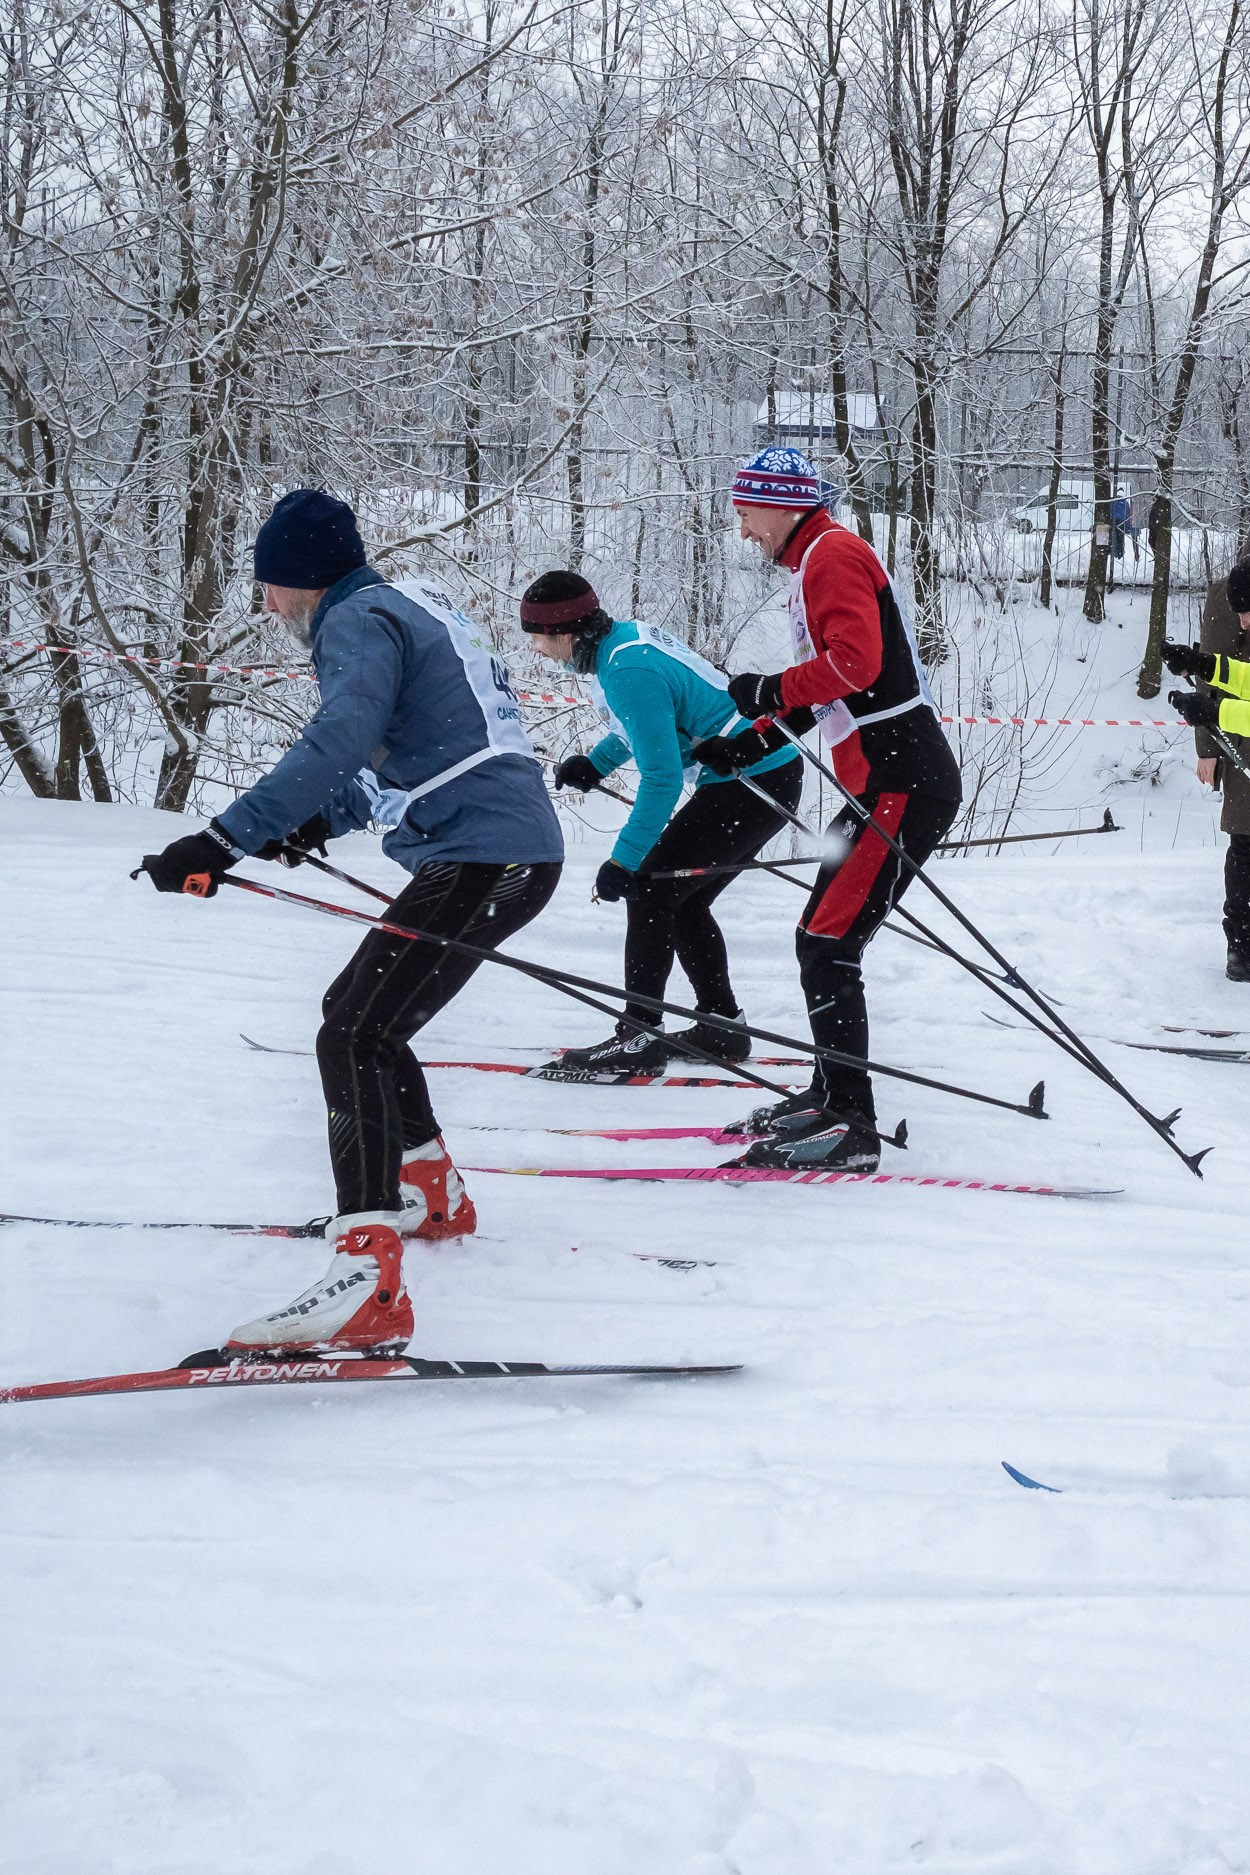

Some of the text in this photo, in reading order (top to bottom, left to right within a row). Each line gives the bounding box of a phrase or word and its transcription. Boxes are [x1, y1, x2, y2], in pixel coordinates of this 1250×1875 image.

[754, 675, 765, 705] NORDWA
[537, 1069, 598, 1082] ATOMIC
[266, 1271, 366, 1322] alpna
[188, 1362, 342, 1384] PELTONEN
